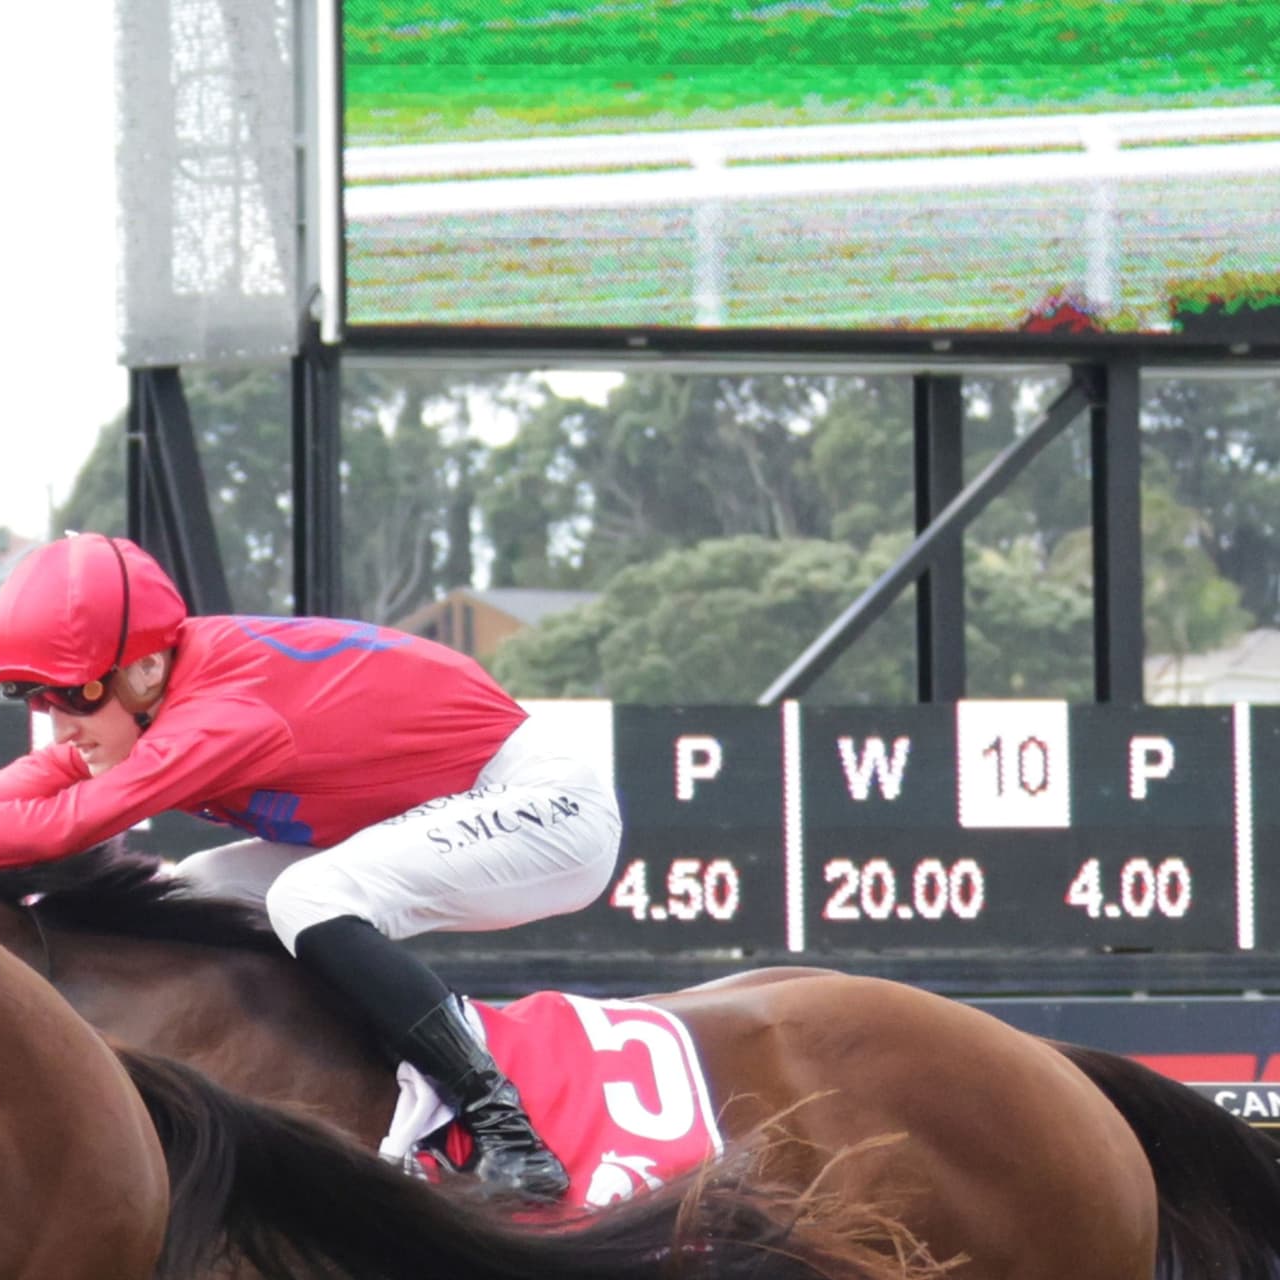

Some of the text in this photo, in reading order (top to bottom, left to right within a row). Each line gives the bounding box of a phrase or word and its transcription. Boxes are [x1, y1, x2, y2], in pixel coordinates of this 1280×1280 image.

[676, 735, 723, 801] P
[838, 735, 1176, 801] W 10 P
[611, 858, 740, 921] 4.50
[823, 857, 1193, 920] 20.00 4.00
[569, 998, 696, 1142] 5
